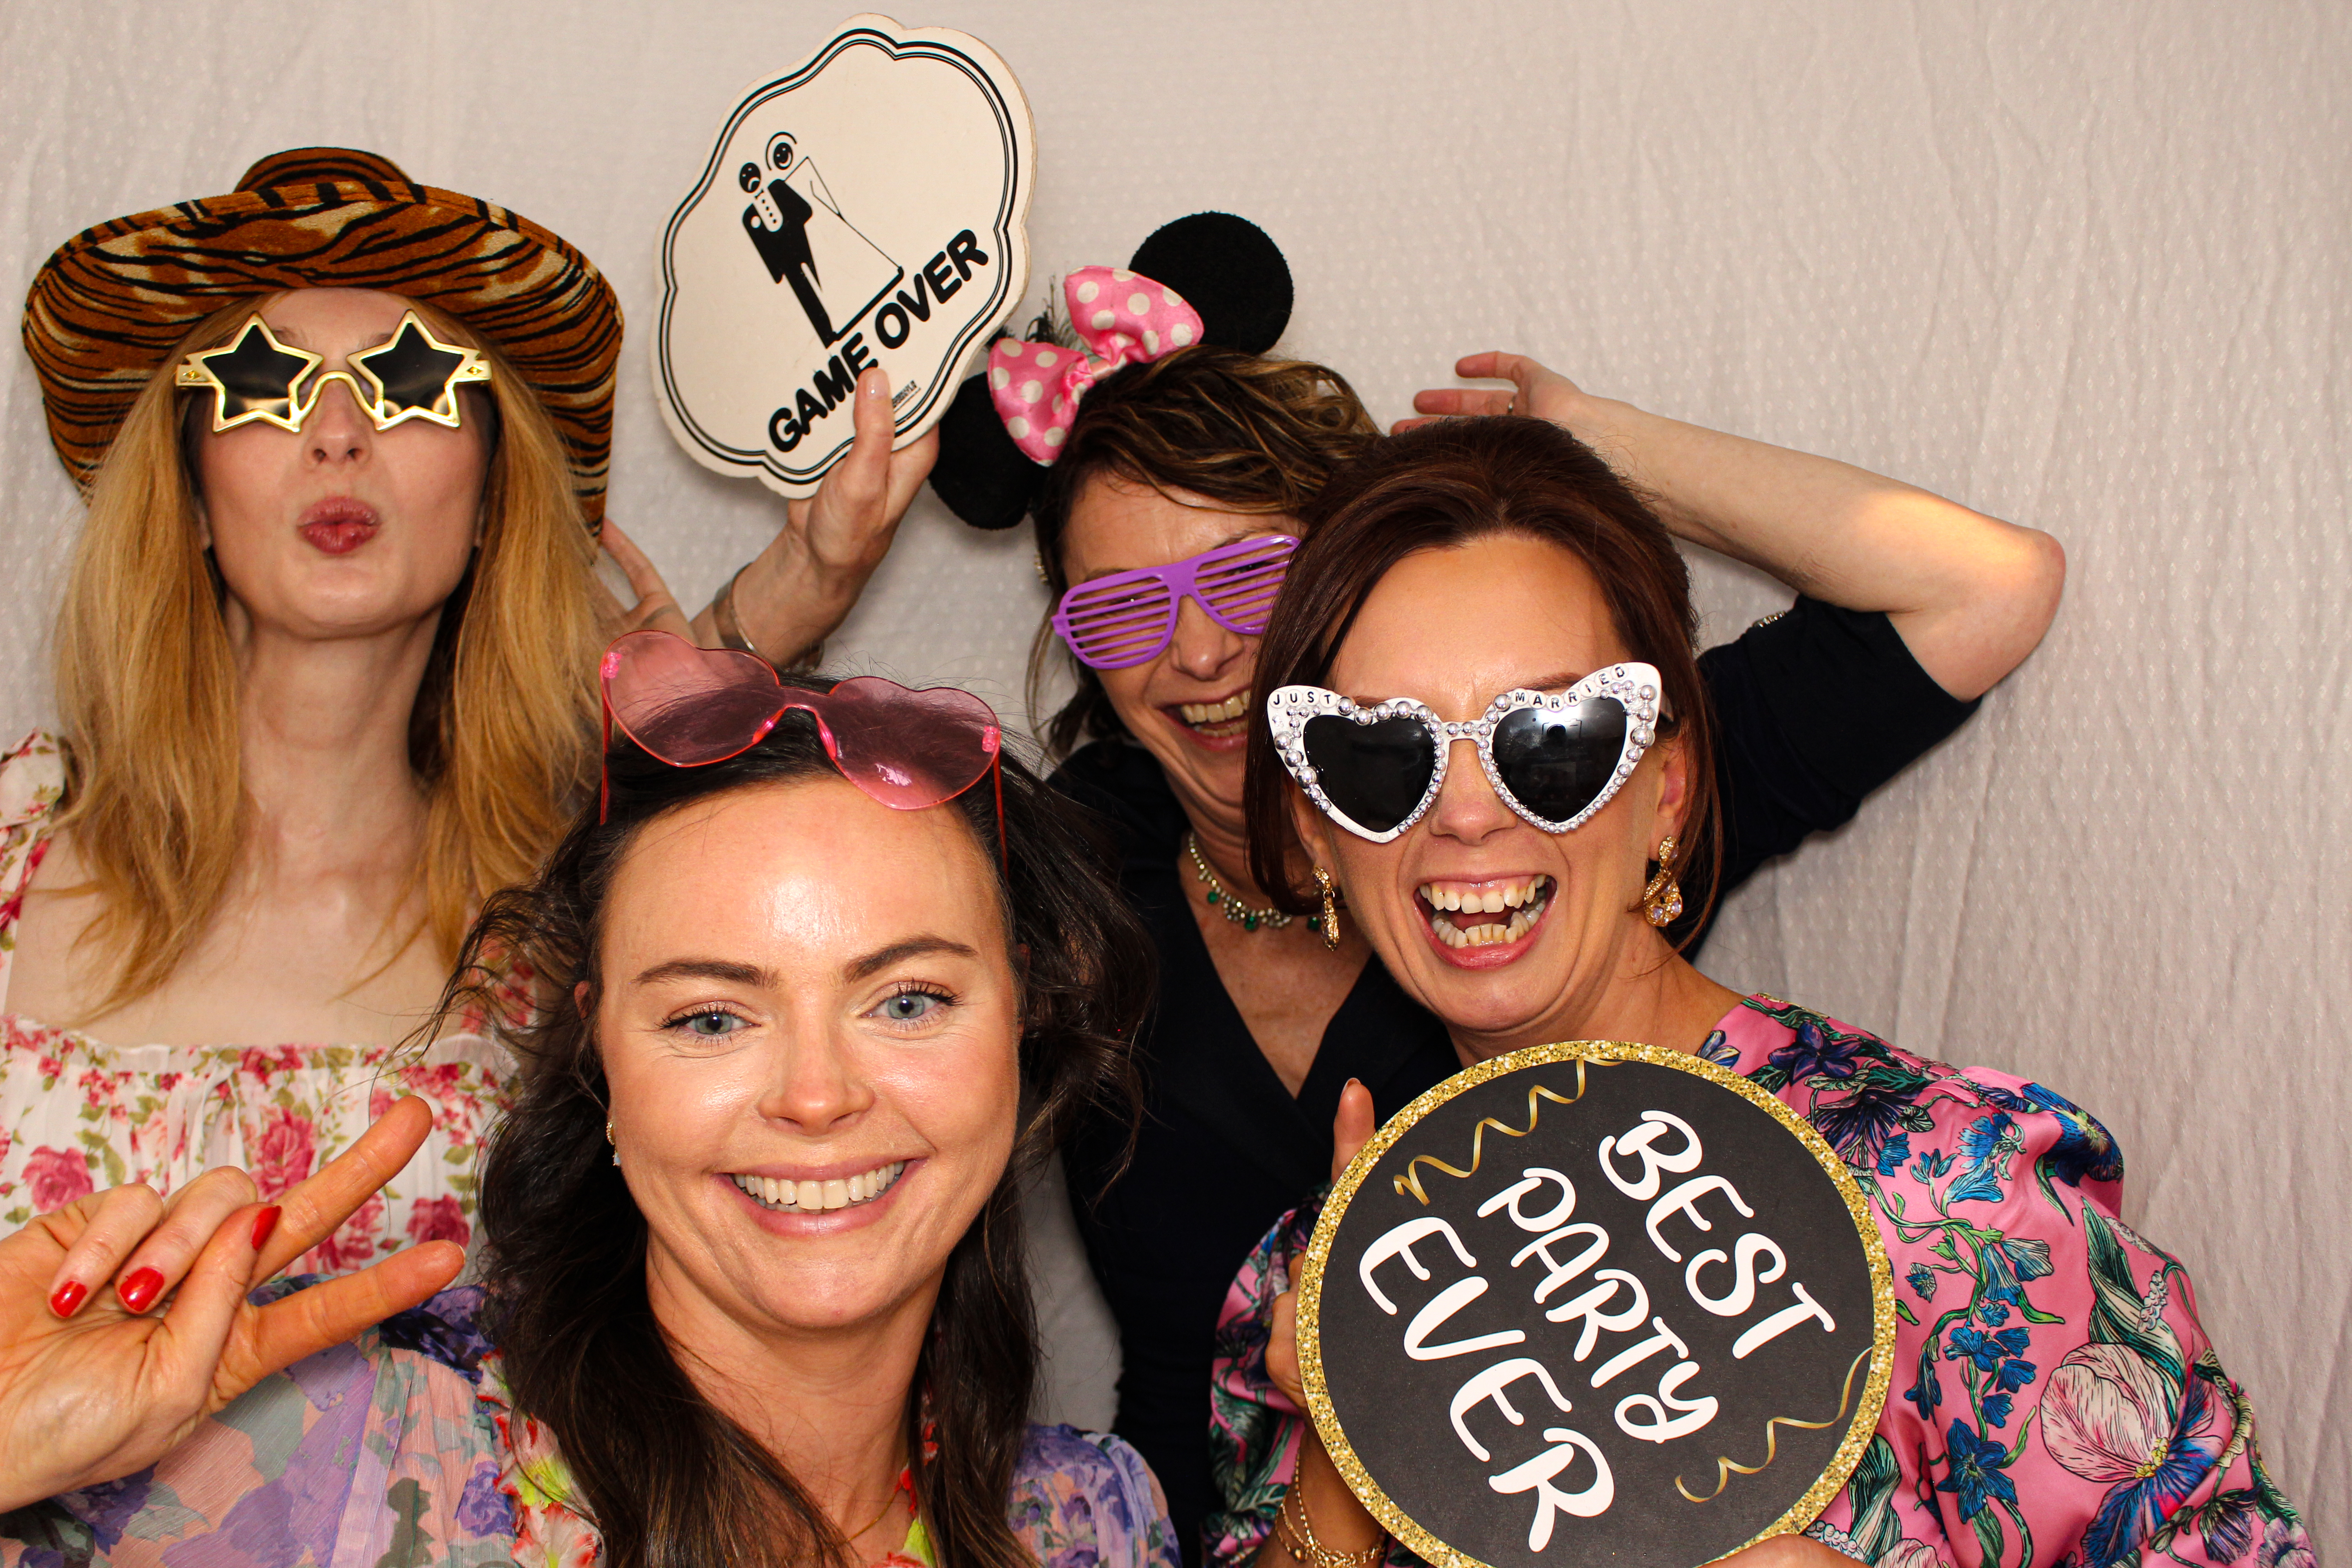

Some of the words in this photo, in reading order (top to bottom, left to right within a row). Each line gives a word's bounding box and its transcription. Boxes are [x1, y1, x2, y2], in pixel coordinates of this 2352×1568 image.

[769, 333, 878, 452] GAME
[875, 229, 989, 349] OVER
[1273, 691, 1331, 706] JUST
[1515, 666, 1625, 709] MARRIED
[1477, 1167, 1719, 1445] PARTY
[1598, 1110, 1836, 1359] BEST
[1359, 1217, 1614, 1553] EVER
